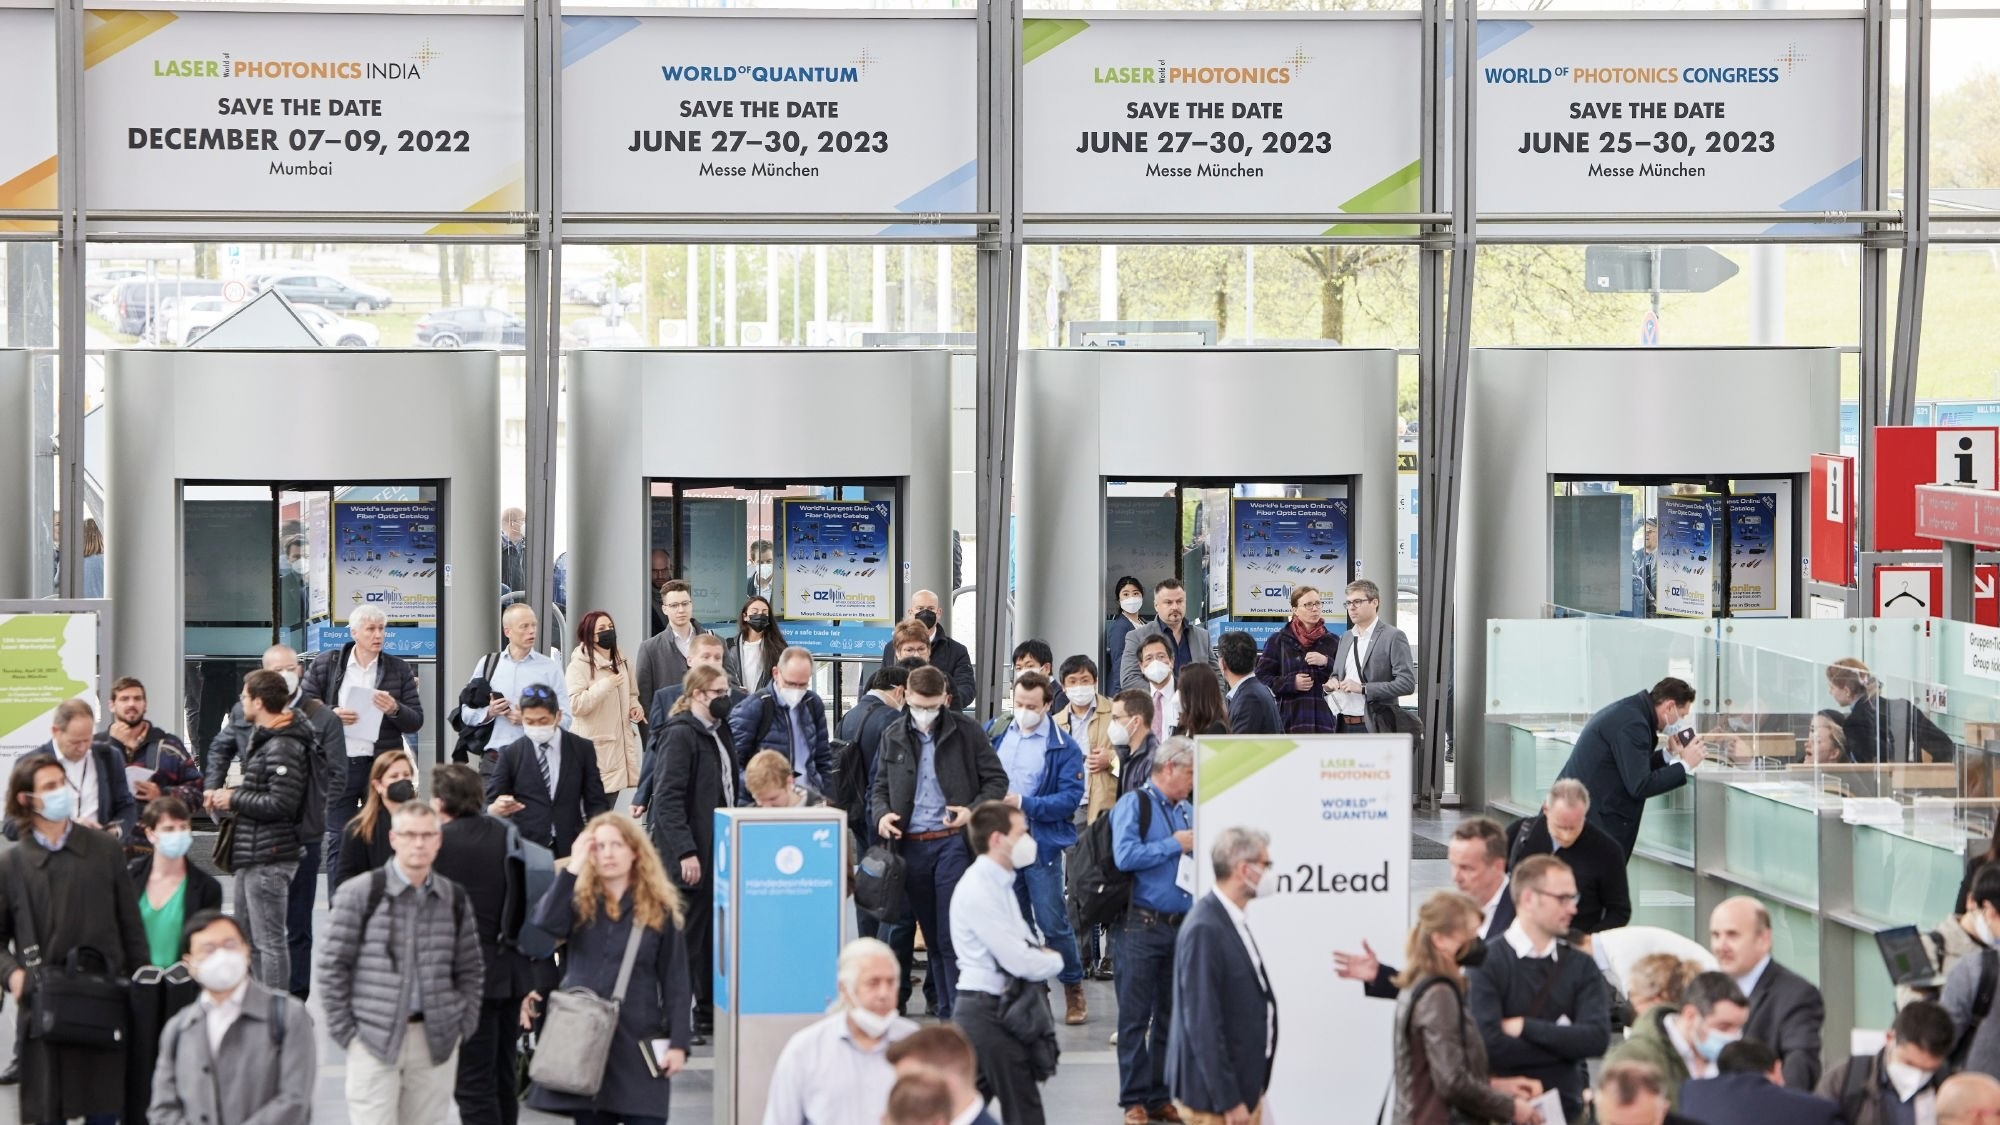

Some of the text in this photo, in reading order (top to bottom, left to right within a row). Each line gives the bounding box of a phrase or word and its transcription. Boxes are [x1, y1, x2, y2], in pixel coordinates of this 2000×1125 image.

[154, 60, 421, 79] LASER PHOTONICS INDIA
[1094, 67, 1290, 84] LASER PHOTONICS
[1485, 67, 1779, 84] WORLD OF PHOTONICS CONGRESS
[218, 97, 382, 116] SAVE THE DATE
[680, 100, 839, 118] SAVE THE DATE
[1126, 102, 1283, 119] SAVE THE DATE
[1569, 102, 1725, 119] SAVE THE DATE
[128, 127, 470, 155] DECEMBER 07–09, 2022
[628, 130, 889, 156] JUNE 27–30, 2023
[1076, 131, 1332, 156] JUNE 27–30, 2023
[1518, 131, 1775, 156] JUNE 25–30, 2023
[269, 161, 332, 176] Mumbai
[699, 162, 819, 177] Messe München
[1146, 162, 1264, 177] Messe München
[1588, 162, 1706, 177] Messe München
[1954, 437, 1977, 483] i
[366, 593, 383, 601] OZ
[814, 591, 828, 600] OZ
[1265, 588, 1281, 596] OZ
[1973, 654, 1990, 672] Group
[1320, 759, 1355, 768] LASER
[1320, 770, 1391, 780] PHOTONICS
[1321, 799, 1368, 808] WORLD
[1322, 811, 1388, 820] QUANTUM
[1277, 861, 1389, 893] n2Lead
